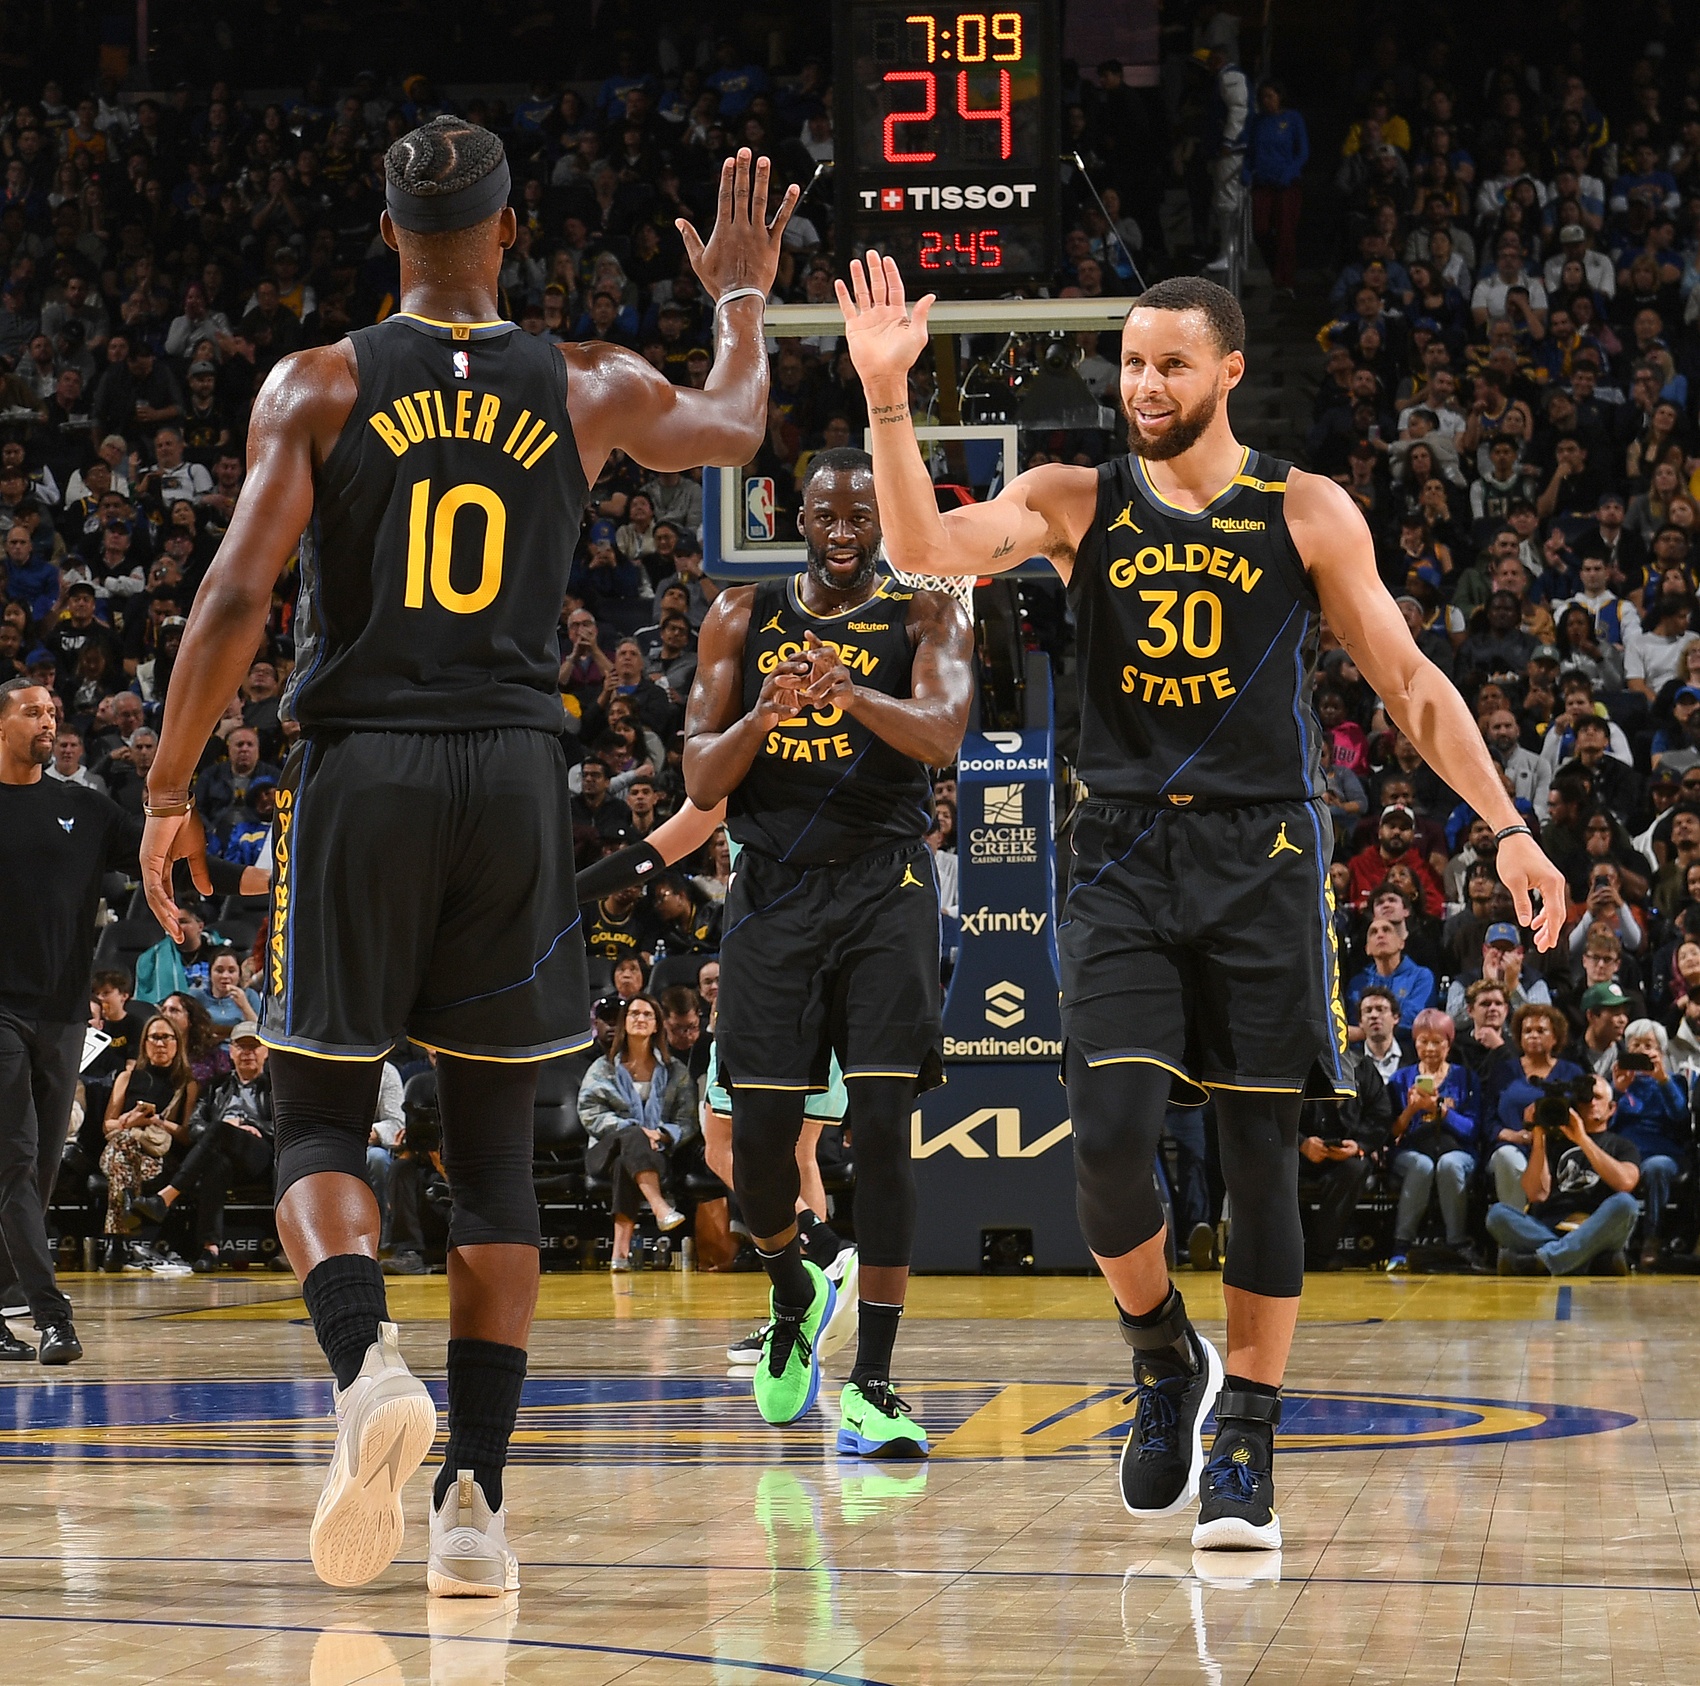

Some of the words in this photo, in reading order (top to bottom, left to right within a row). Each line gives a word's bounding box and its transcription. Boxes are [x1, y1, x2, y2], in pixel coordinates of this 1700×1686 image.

[905, 12, 1022, 63] 7:09
[882, 68, 1011, 163] 24
[907, 184, 1037, 211] TISSOT
[920, 230, 1001, 268] 2:45
[368, 389, 501, 458] BUTLER
[502, 408, 559, 471] III
[1211, 517, 1266, 533] Rakuten
[404, 478, 507, 614] 10
[1109, 543, 1263, 594] GOLDEN
[848, 621, 890, 633] Rakuten
[1137, 590, 1222, 658] 30
[1121, 664, 1237, 707] STATE
[766, 731, 853, 763] STATE
[960, 758, 1049, 772] DOORDASH
[969, 827, 1037, 842] CACHE
[969, 841, 1038, 856] CREEK
[971, 855, 1003, 864] CASINO
[1006, 855, 1038, 863] RESORT
[270, 789, 293, 997] WARRIORS
[960, 906, 1048, 936] xfinity
[590, 931, 637, 948] GOLDEN
[220, 1238, 258, 1250] ASE
